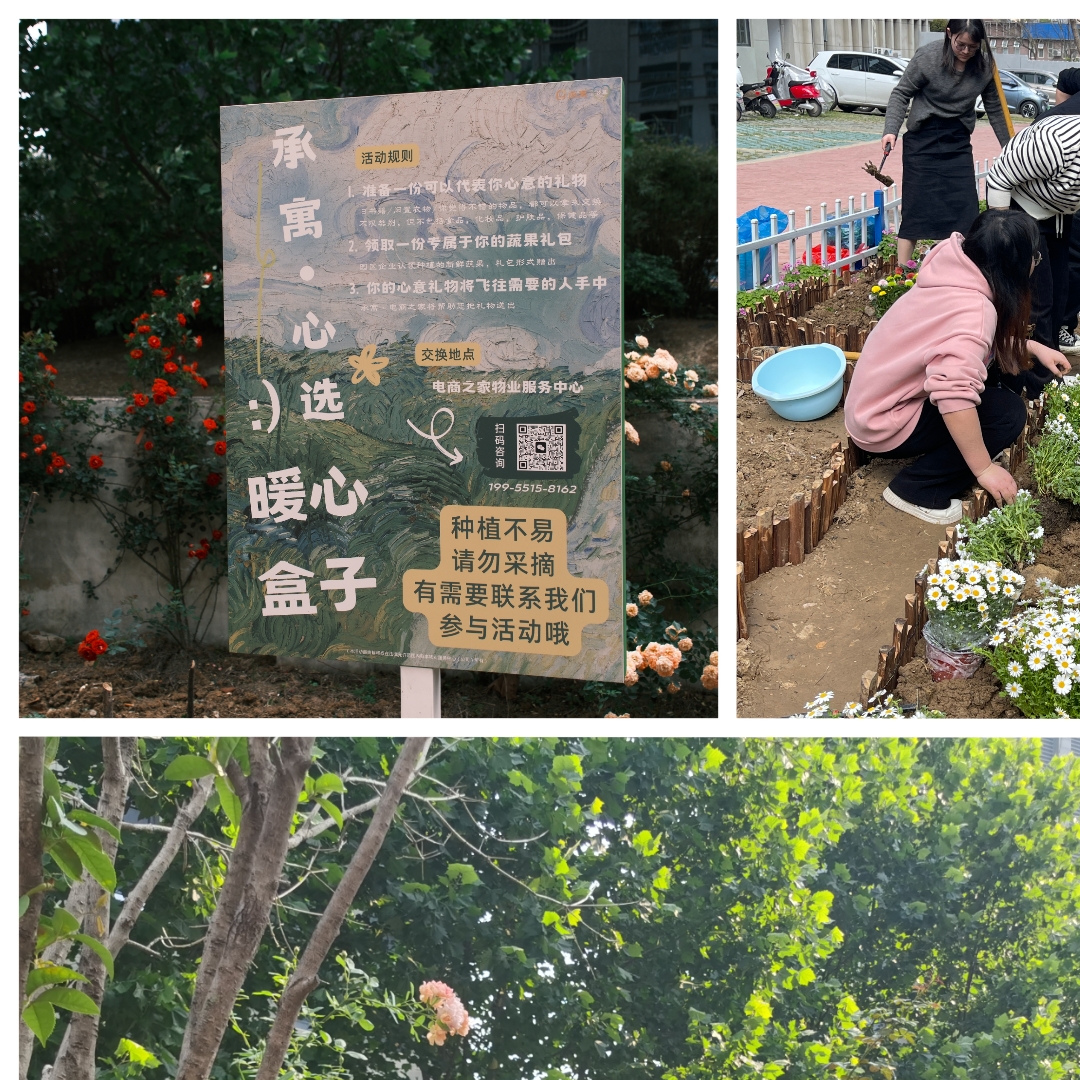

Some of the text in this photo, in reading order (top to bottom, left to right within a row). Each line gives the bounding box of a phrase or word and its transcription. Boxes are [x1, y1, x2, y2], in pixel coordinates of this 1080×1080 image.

[360, 148, 414, 166] 活动规则
[362, 173, 588, 198] 准备一份可以代表你心意的礼物
[349, 232, 573, 252] 2. 领取一份专属于你的蔬果礼包
[349, 275, 608, 294] 3. 你的心意礼物将飞往需要的人手中
[420, 347, 476, 362] 交换地点
[432, 379, 584, 395] 电商之家物业服务中心
[494, 423, 506, 470] 扫码咨询
[248, 465, 369, 524] 暖心
[488, 482, 577, 495] 199-5515-8162
[451, 515, 554, 544] 种植不易
[451, 549, 555, 578] 请勿采摘
[258, 556, 377, 617] 盒子
[413, 579, 597, 615] 有需要联系我们
[439, 614, 571, 646] 参与活动哦
